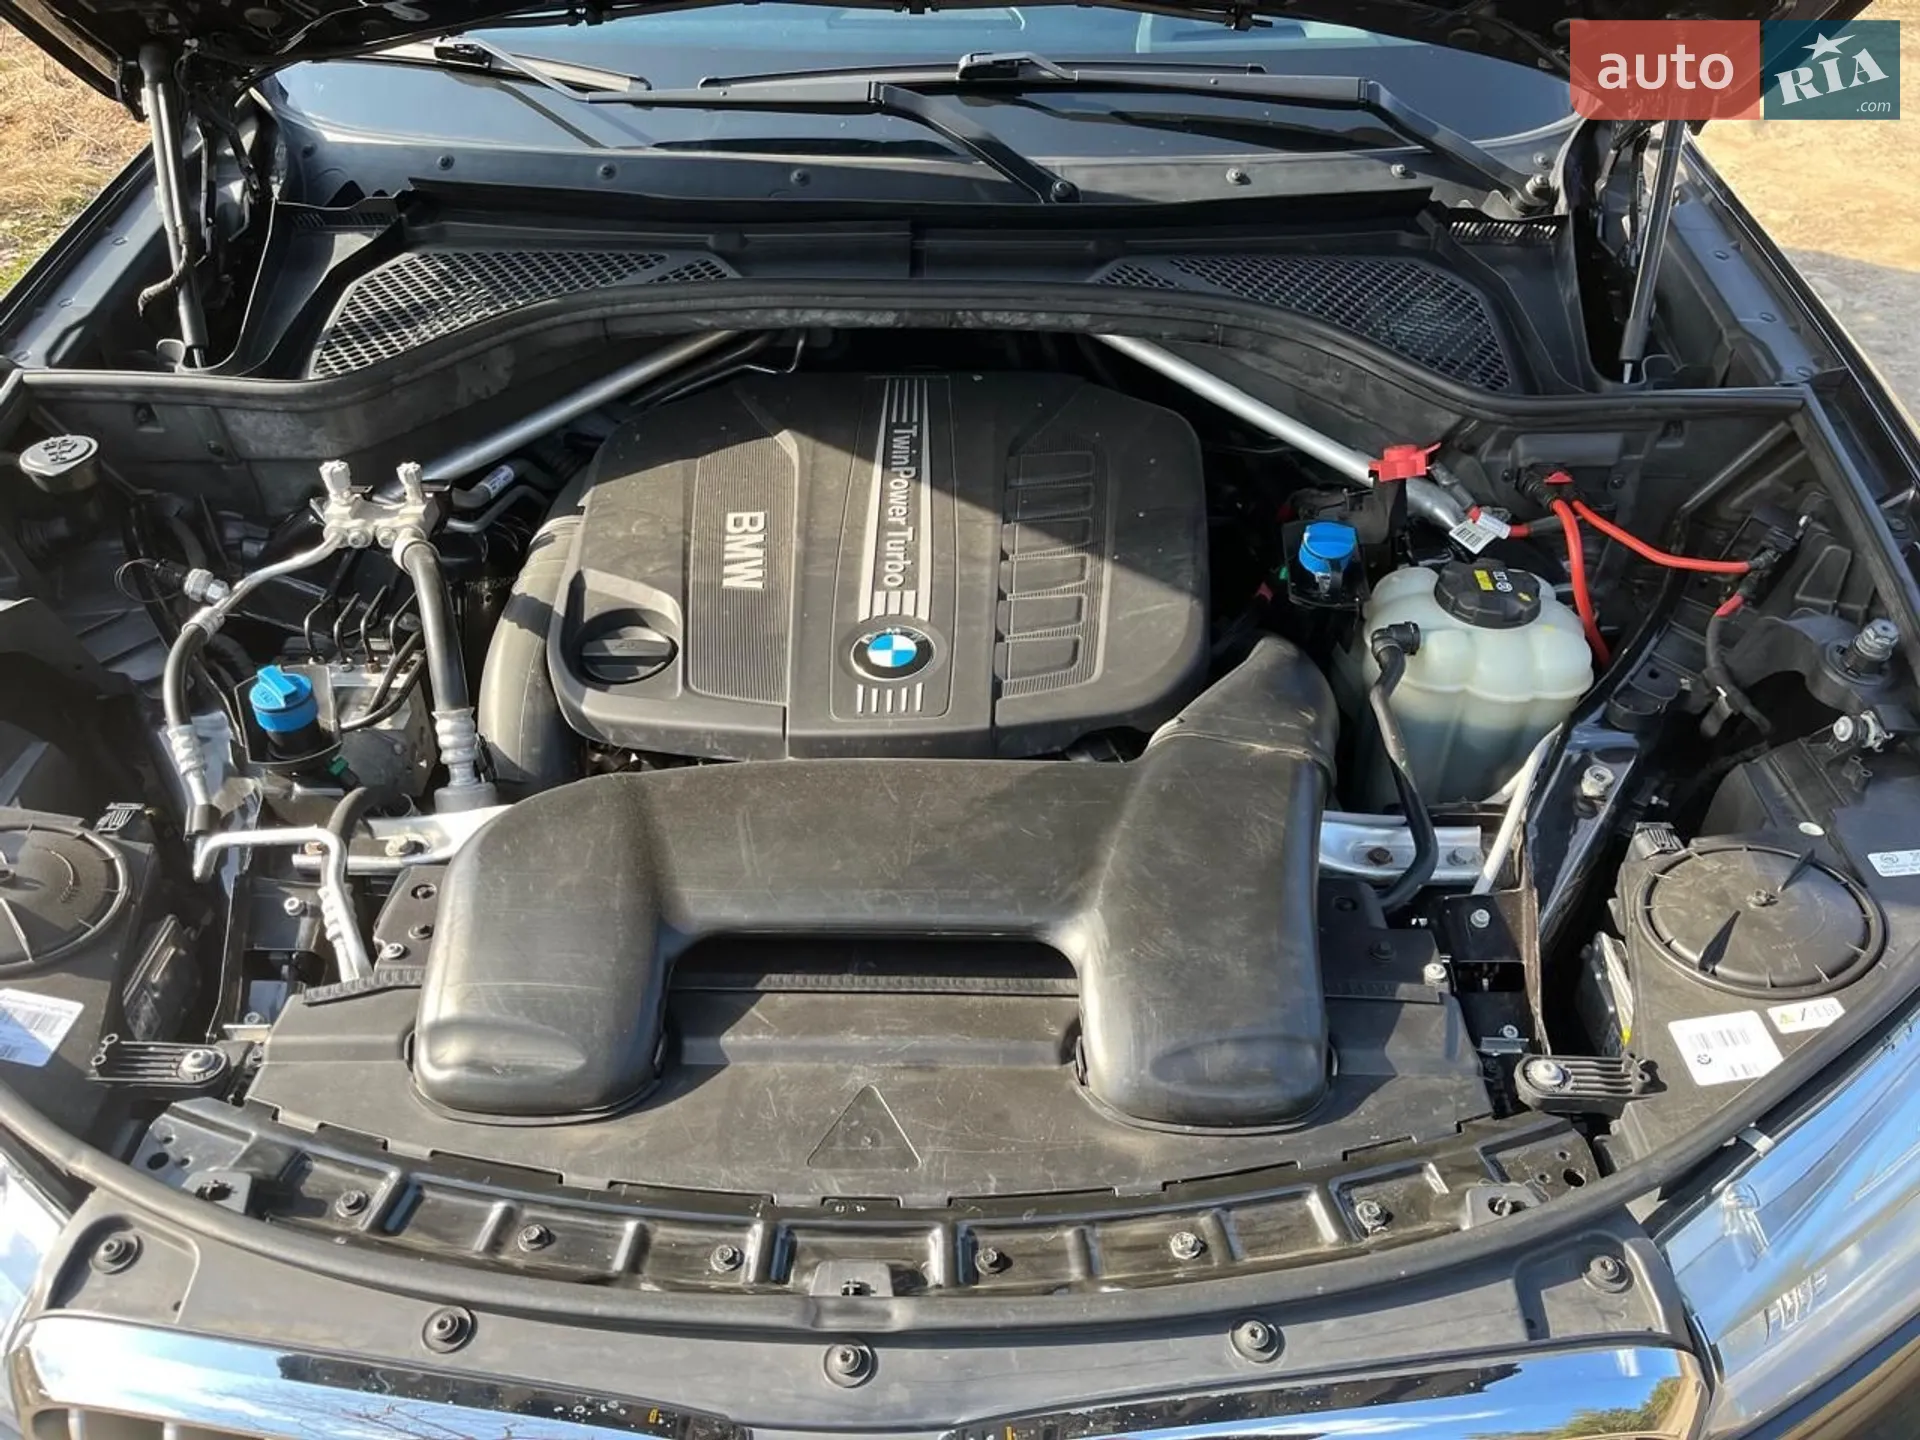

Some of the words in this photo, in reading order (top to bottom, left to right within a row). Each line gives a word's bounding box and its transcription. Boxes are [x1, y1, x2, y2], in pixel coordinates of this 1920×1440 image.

[888, 425, 918, 526] TwinPower
[722, 511, 766, 590] BMW
[883, 526, 914, 588] Turbo
